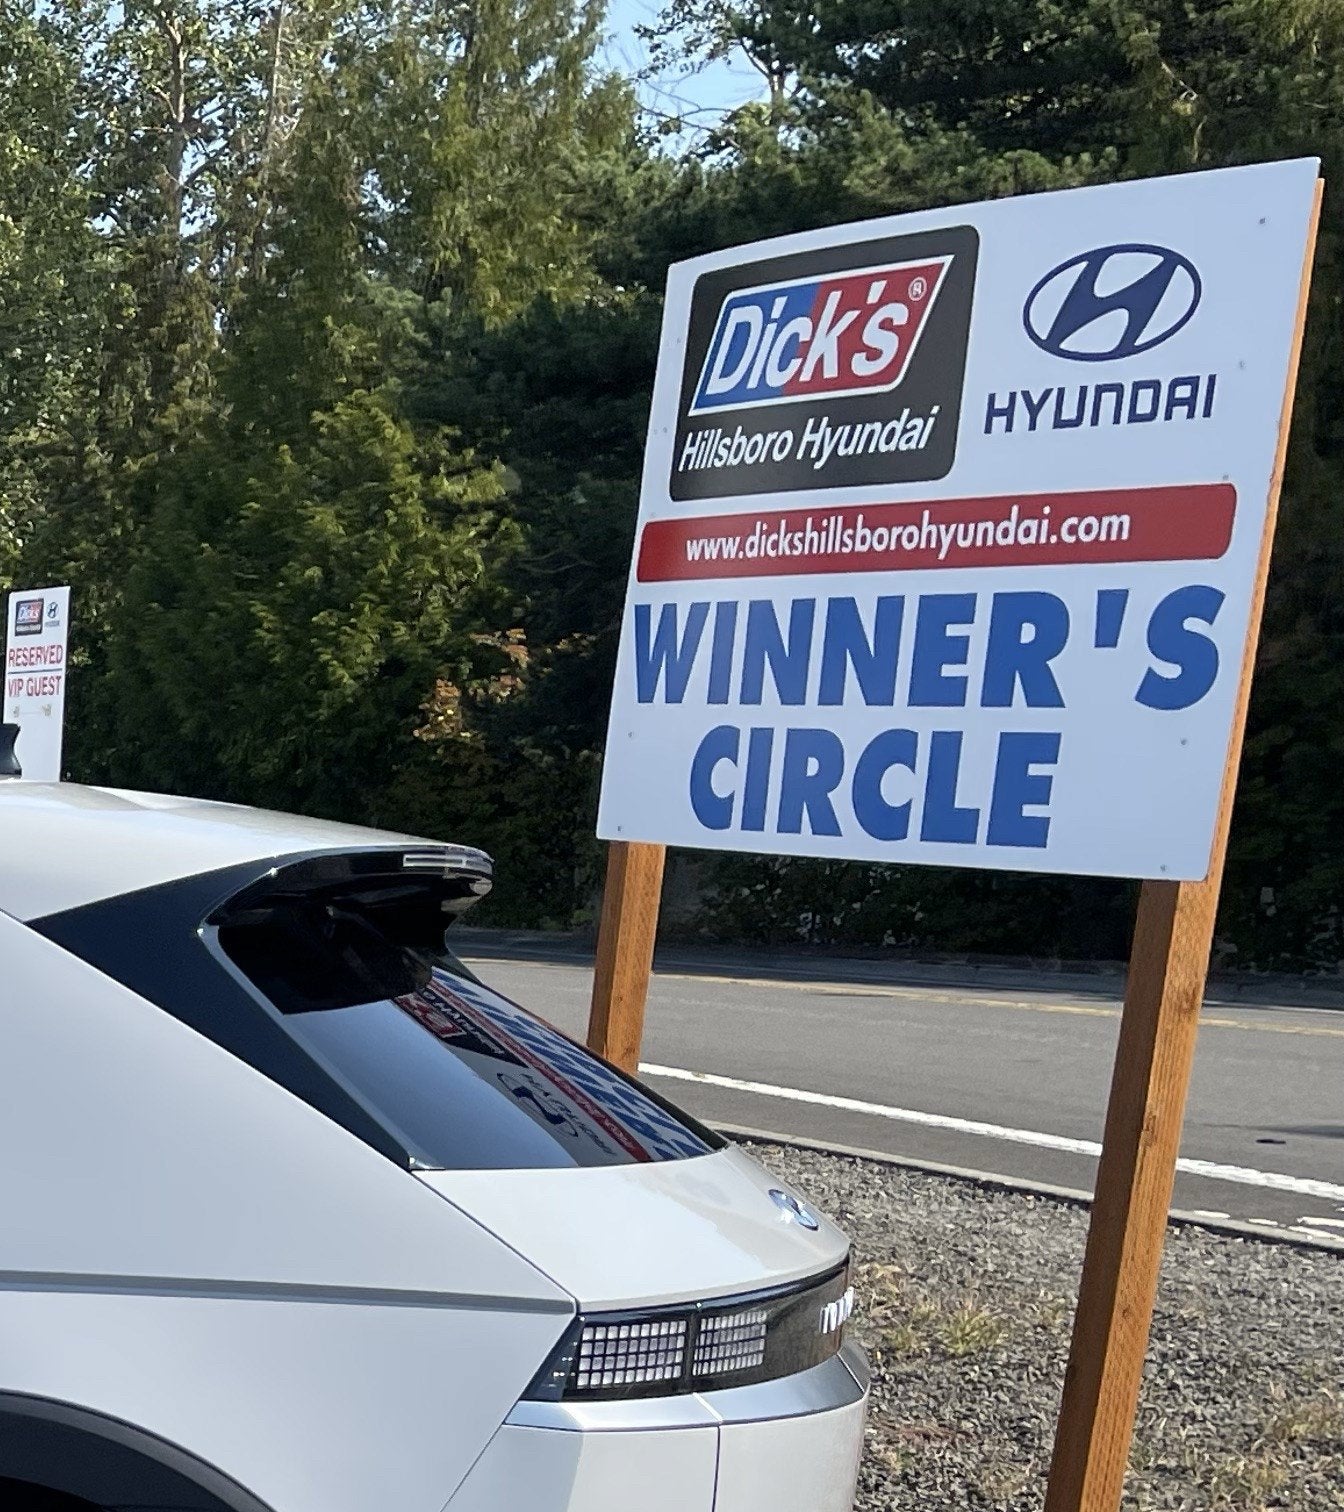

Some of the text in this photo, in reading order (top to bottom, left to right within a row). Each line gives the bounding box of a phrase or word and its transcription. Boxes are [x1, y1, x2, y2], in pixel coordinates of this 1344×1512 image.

[705, 280, 910, 396] Dick's
[984, 374, 1217, 434] HYUNDAI
[677, 405, 942, 472] Hillsboro Hyundai
[685, 505, 1131, 561] www.dickshillsborohyundai.com
[8, 644, 64, 667] RESERVED
[633, 584, 1226, 711] WINNER'S
[7, 675, 62, 698] VIP GUEST
[688, 724, 1063, 849] CIRCLE
